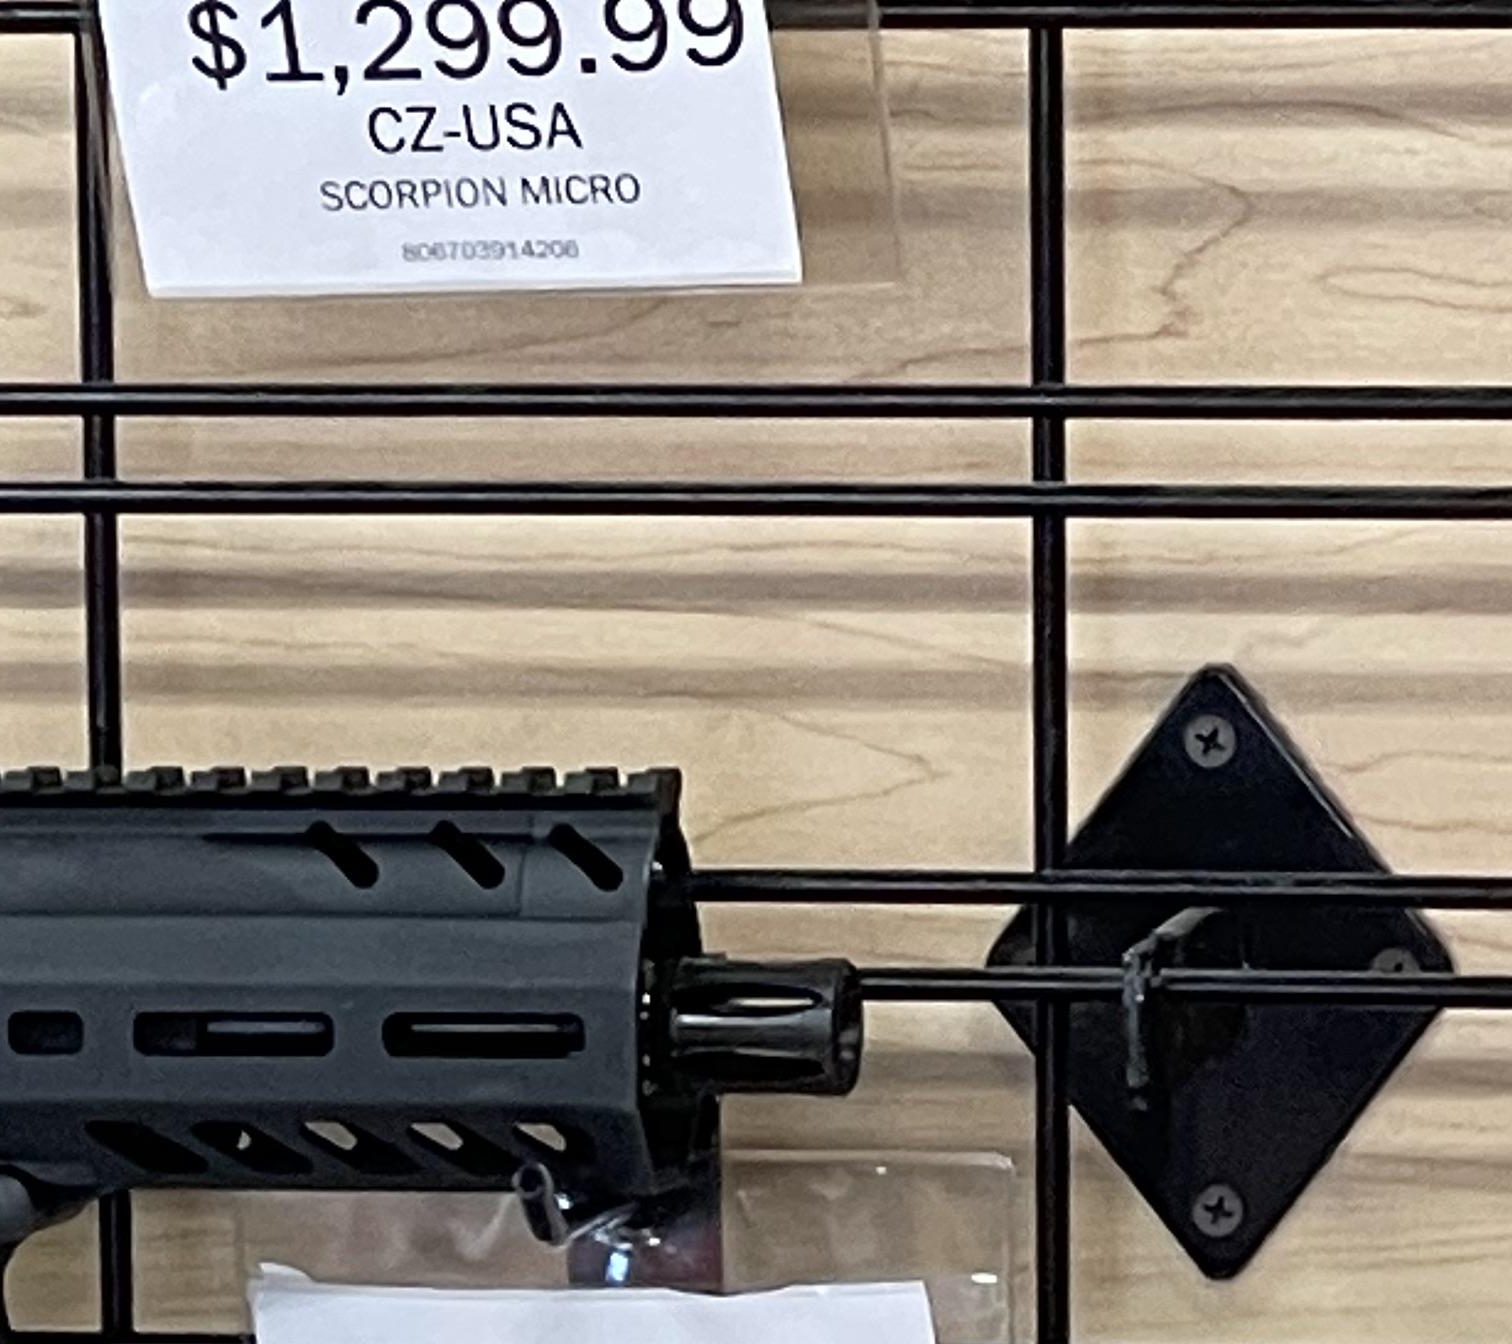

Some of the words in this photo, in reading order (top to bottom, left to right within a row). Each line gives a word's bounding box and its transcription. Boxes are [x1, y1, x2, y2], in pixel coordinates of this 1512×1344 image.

[189, 0, 745, 96] $1,299.99
[368, 102, 583, 154] CZ-USA
[320, 179, 507, 212] SCORPION
[521, 173, 641, 205] MICRO
